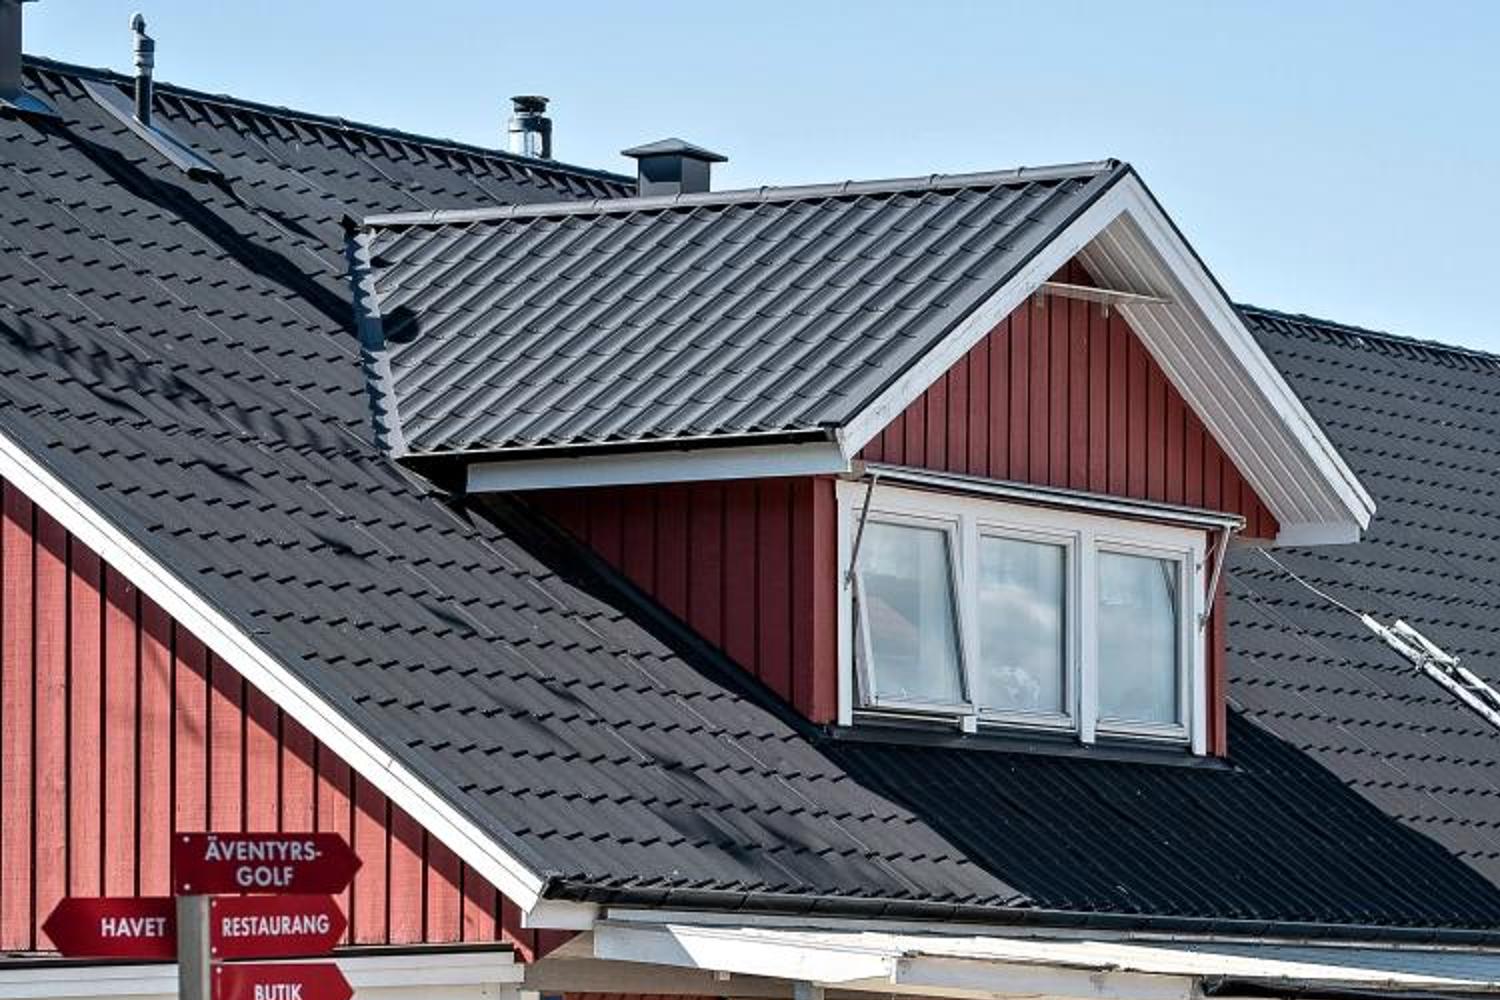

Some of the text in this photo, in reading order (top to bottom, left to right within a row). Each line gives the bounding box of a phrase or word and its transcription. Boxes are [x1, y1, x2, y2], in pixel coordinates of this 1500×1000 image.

[205, 837, 322, 862] ÄVENTYRS-
[236, 866, 294, 886] GOLF
[101, 917, 166, 937] HAVET
[222, 915, 330, 938] RESTAURANG
